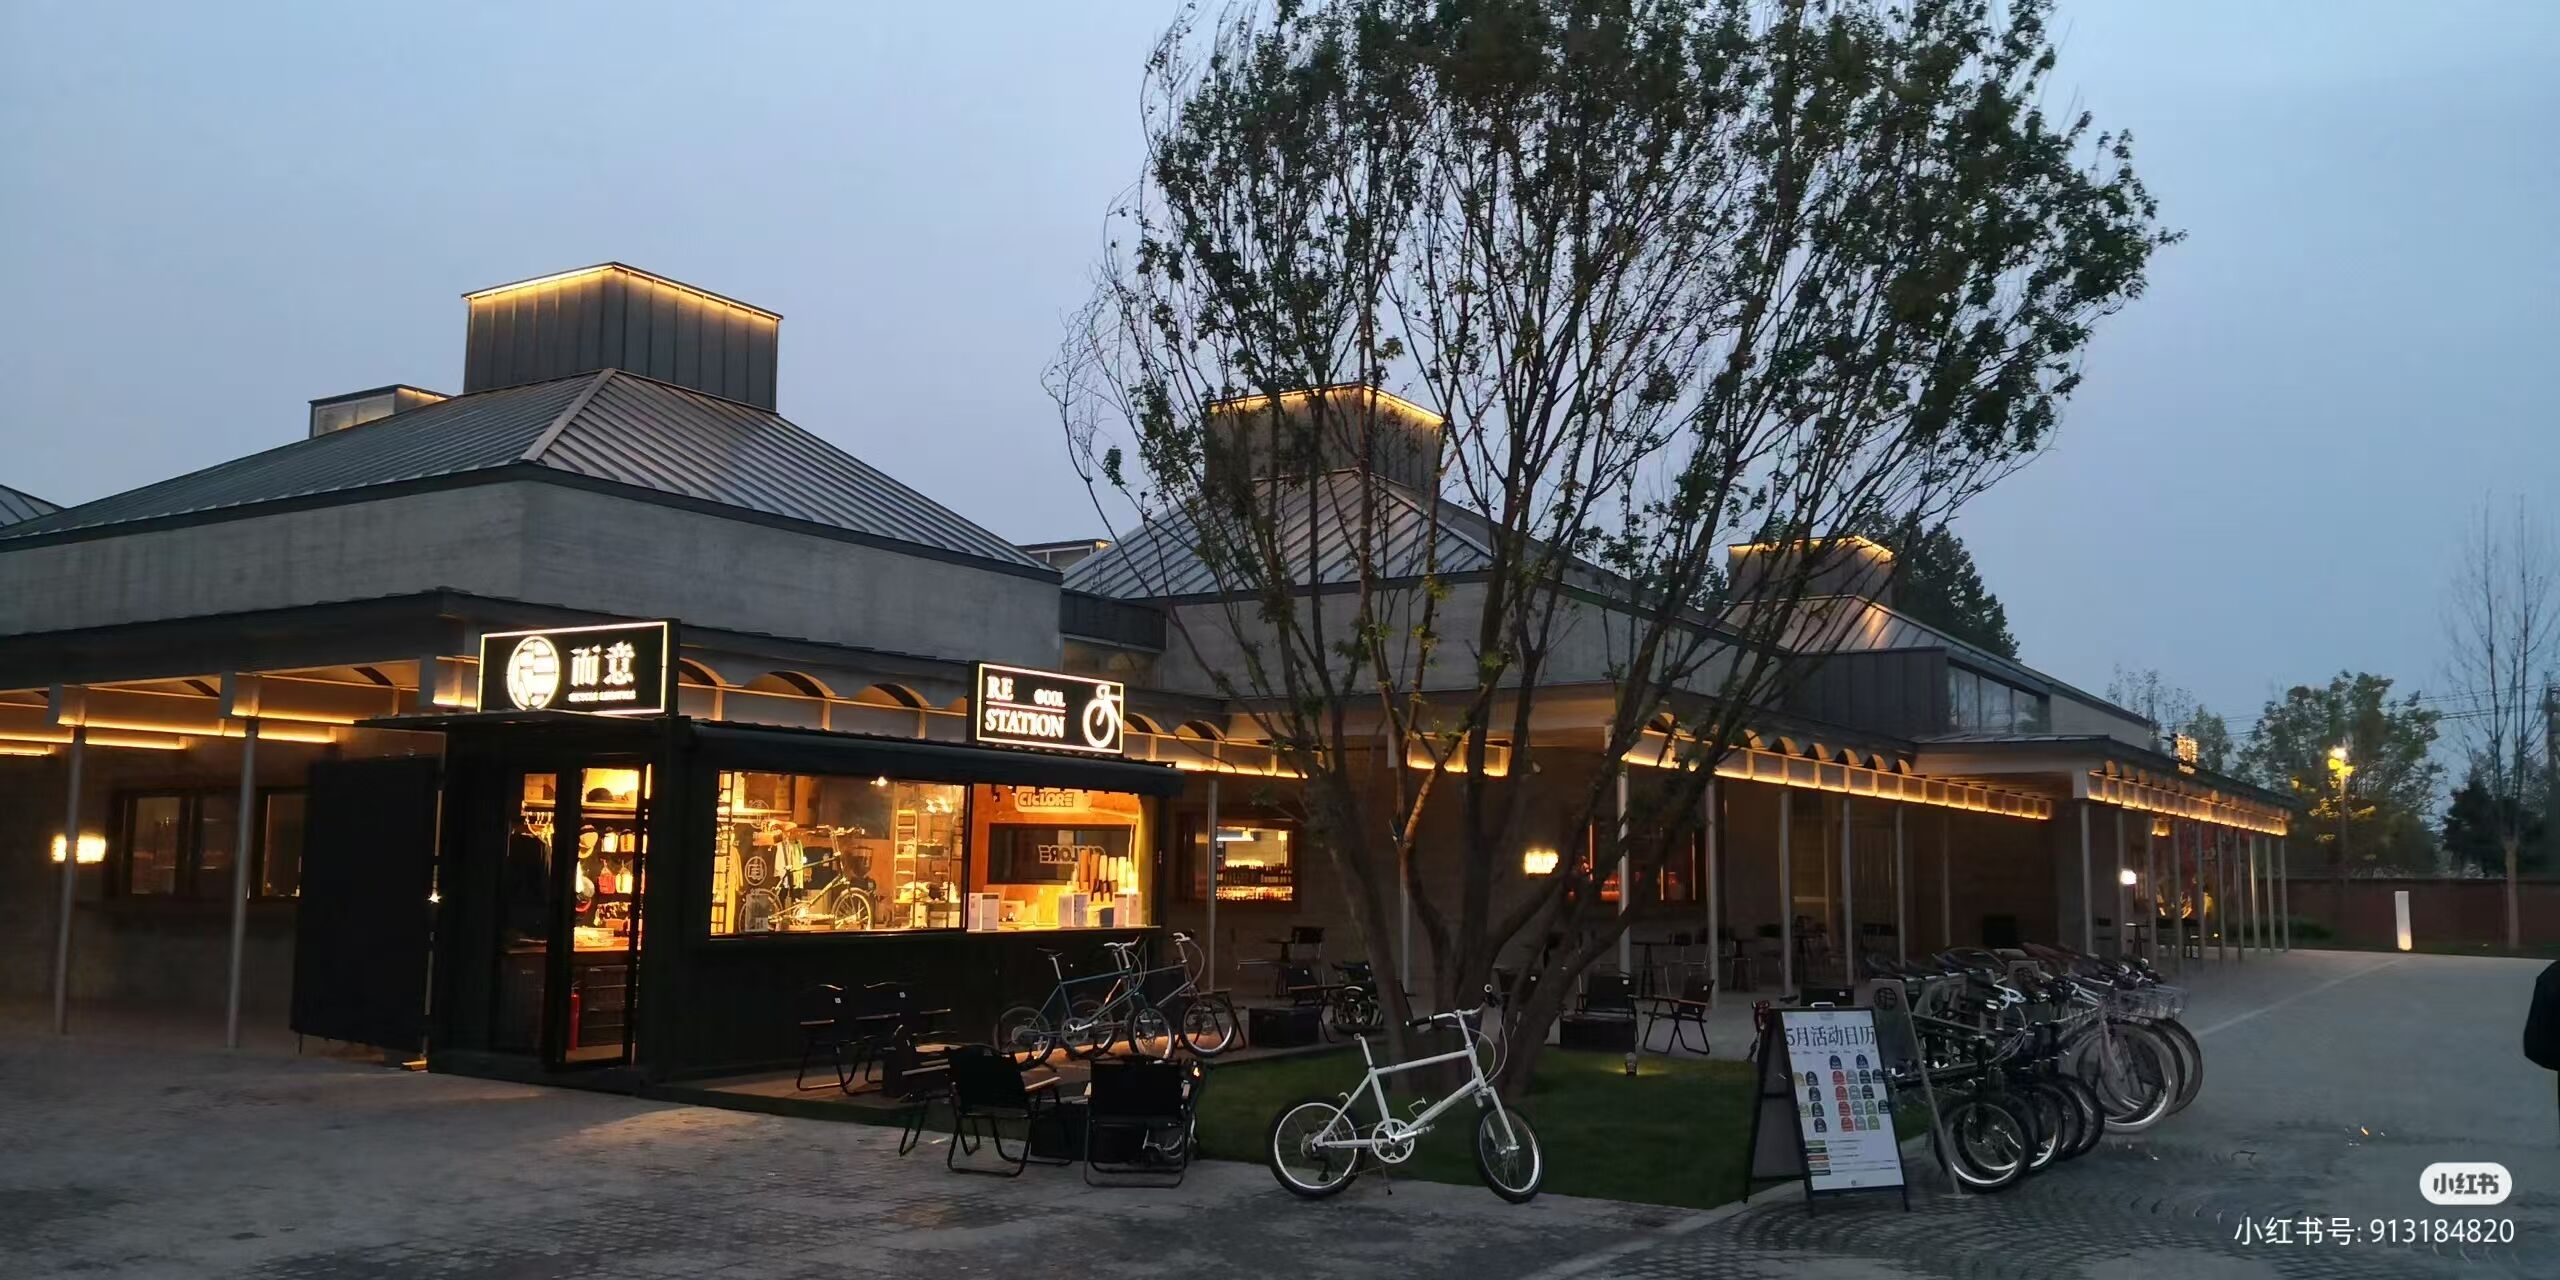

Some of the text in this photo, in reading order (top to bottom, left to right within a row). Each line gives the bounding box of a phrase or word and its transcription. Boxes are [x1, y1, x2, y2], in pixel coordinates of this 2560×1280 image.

[986, 675, 1014, 700] RE
[985, 709, 1065, 738] STATION
[1785, 1024, 1876, 1047] 5月活动日历
